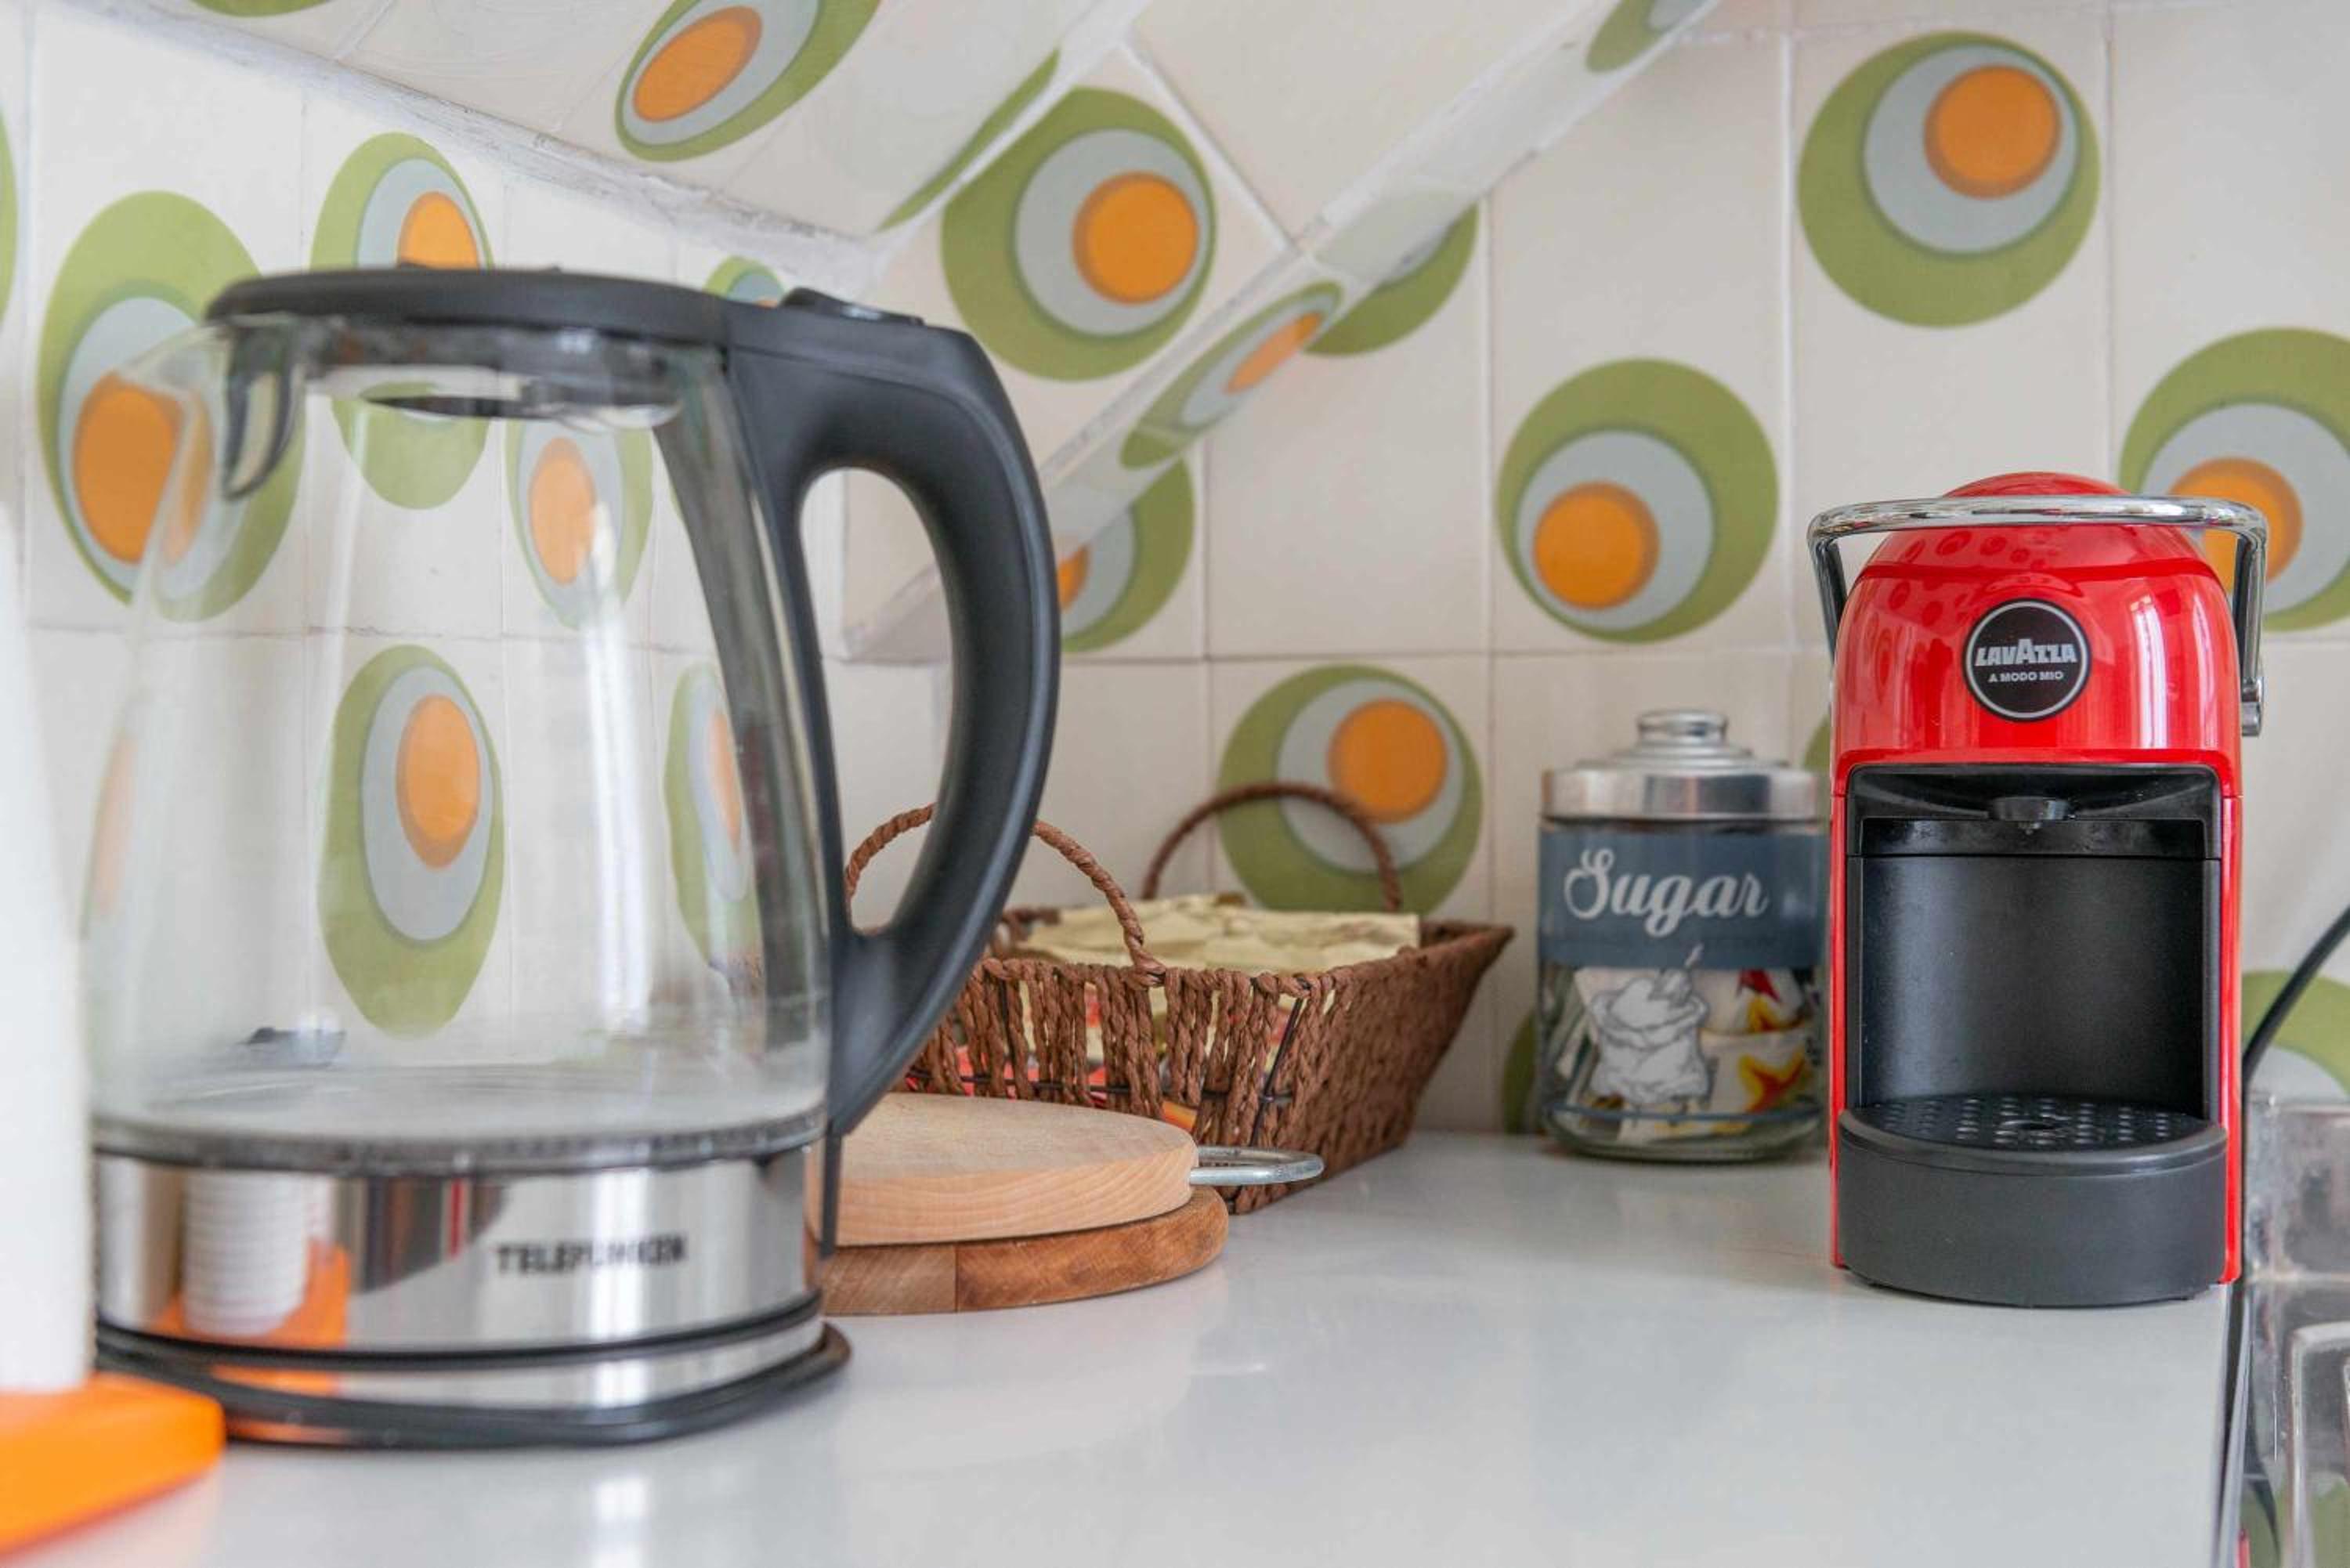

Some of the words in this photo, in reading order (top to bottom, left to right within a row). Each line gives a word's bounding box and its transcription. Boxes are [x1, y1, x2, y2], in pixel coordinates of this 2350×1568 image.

[1975, 638, 2077, 667] LAVAZZA
[1988, 674, 1998, 683] A
[2000, 672, 2037, 682] MODO
[2039, 670, 2063, 681] MIO
[1565, 848, 1768, 937] Sugar
